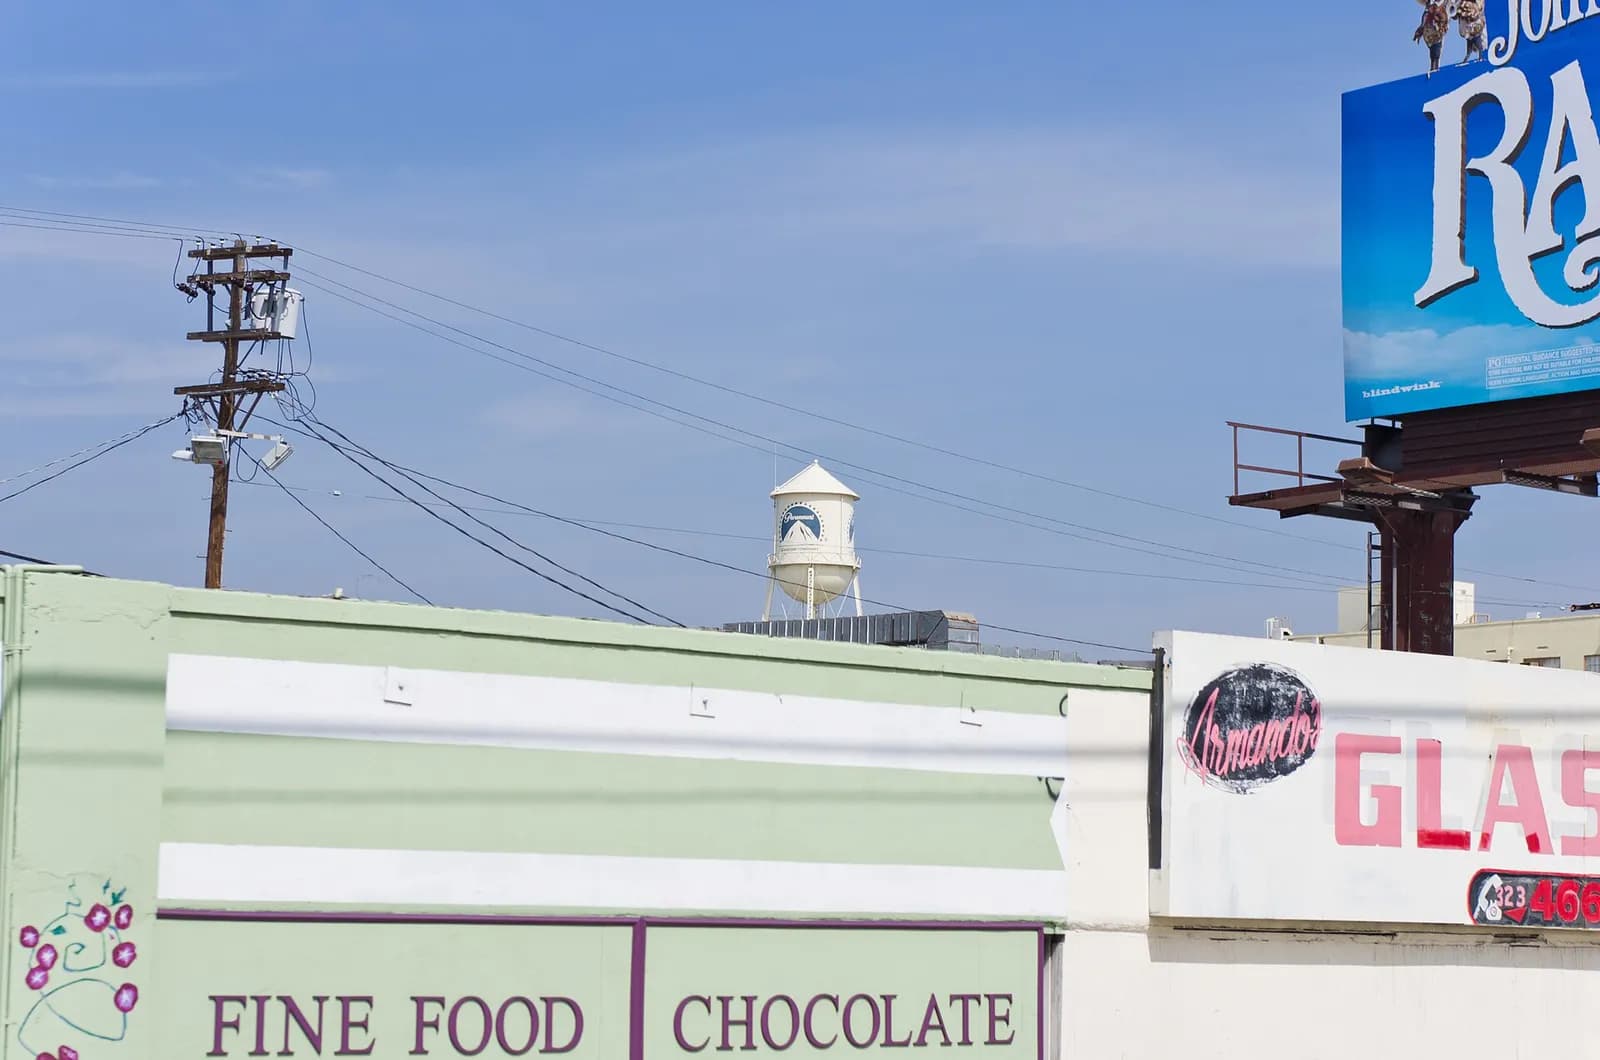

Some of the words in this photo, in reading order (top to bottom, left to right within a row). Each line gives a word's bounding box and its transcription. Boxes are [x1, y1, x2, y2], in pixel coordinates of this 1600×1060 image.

[1362, 381, 1441, 398] blindwink
[1176, 687, 1322, 785] Armando's
[1496, 885, 1526, 908] 323
[206, 994, 377, 1056] FINE
[408, 995, 584, 1056] FOOD
[673, 993, 1015, 1053] CHOCOLATE
